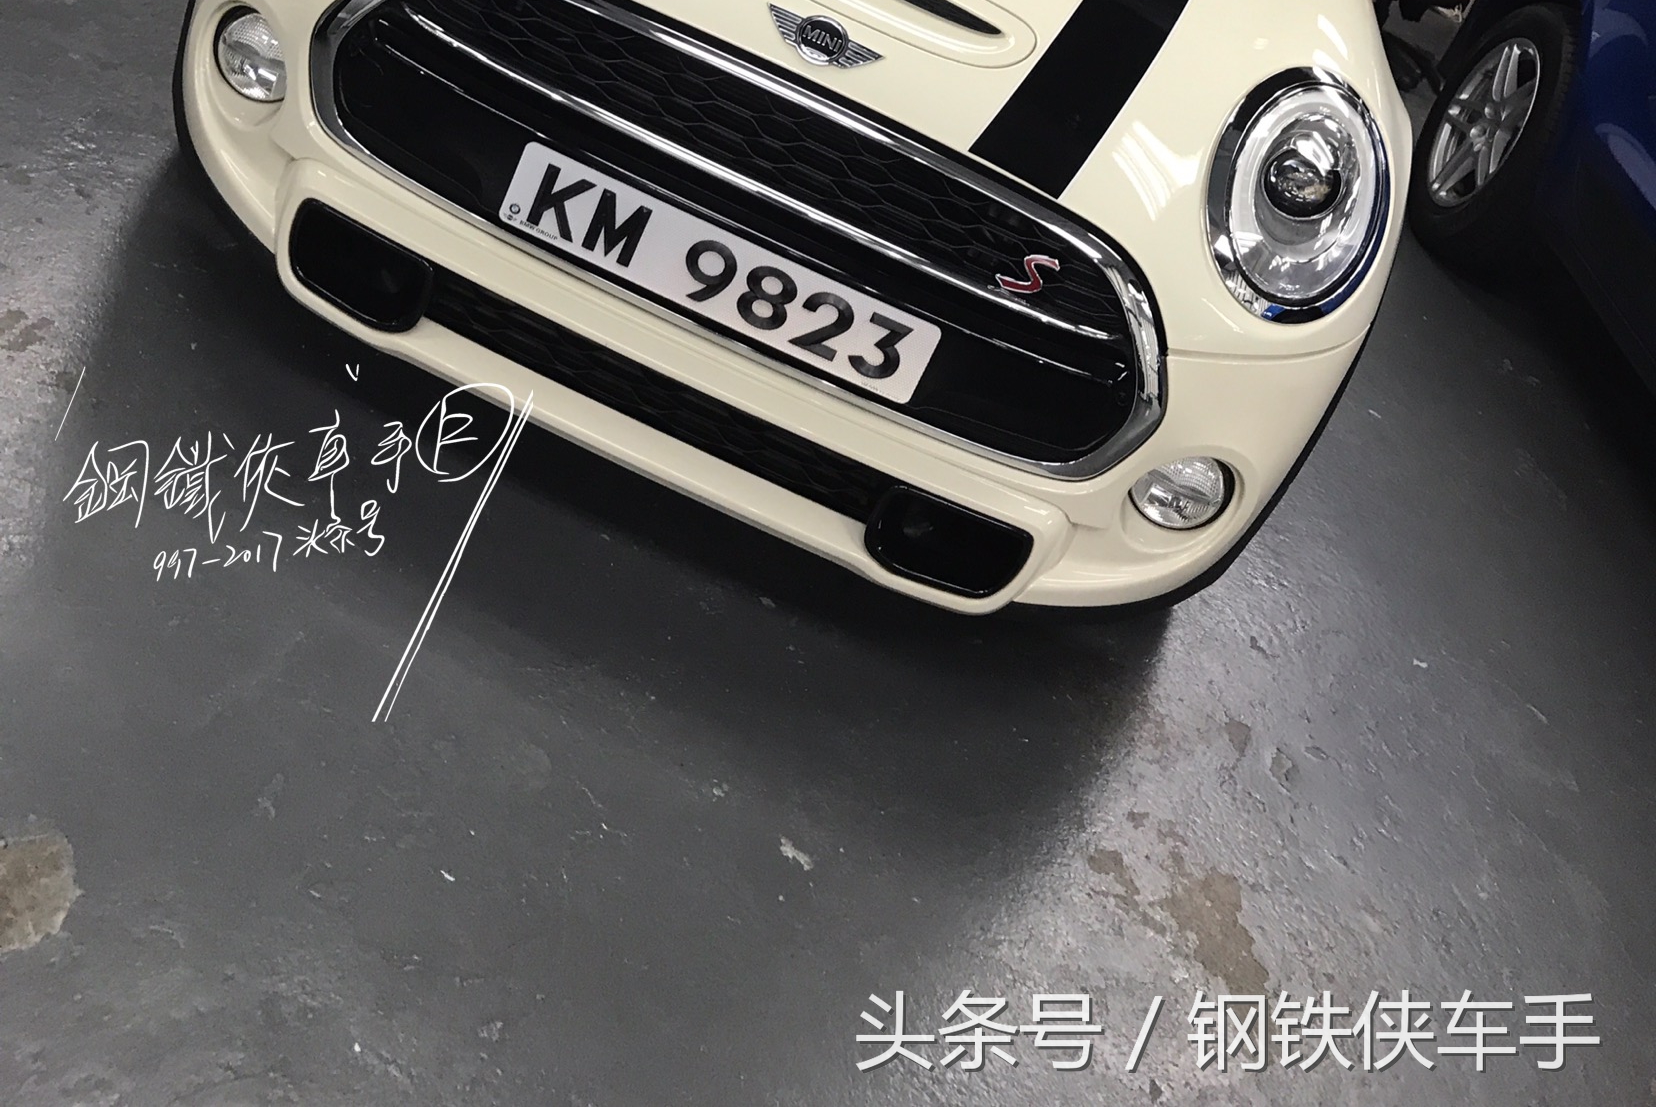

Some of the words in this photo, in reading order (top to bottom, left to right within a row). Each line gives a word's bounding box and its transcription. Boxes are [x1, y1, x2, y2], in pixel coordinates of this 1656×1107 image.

[802, 25, 842, 52] MINI
[527, 163, 653, 268] KM
[685, 239, 914, 379] 9823
[995, 254, 1061, 294] S
